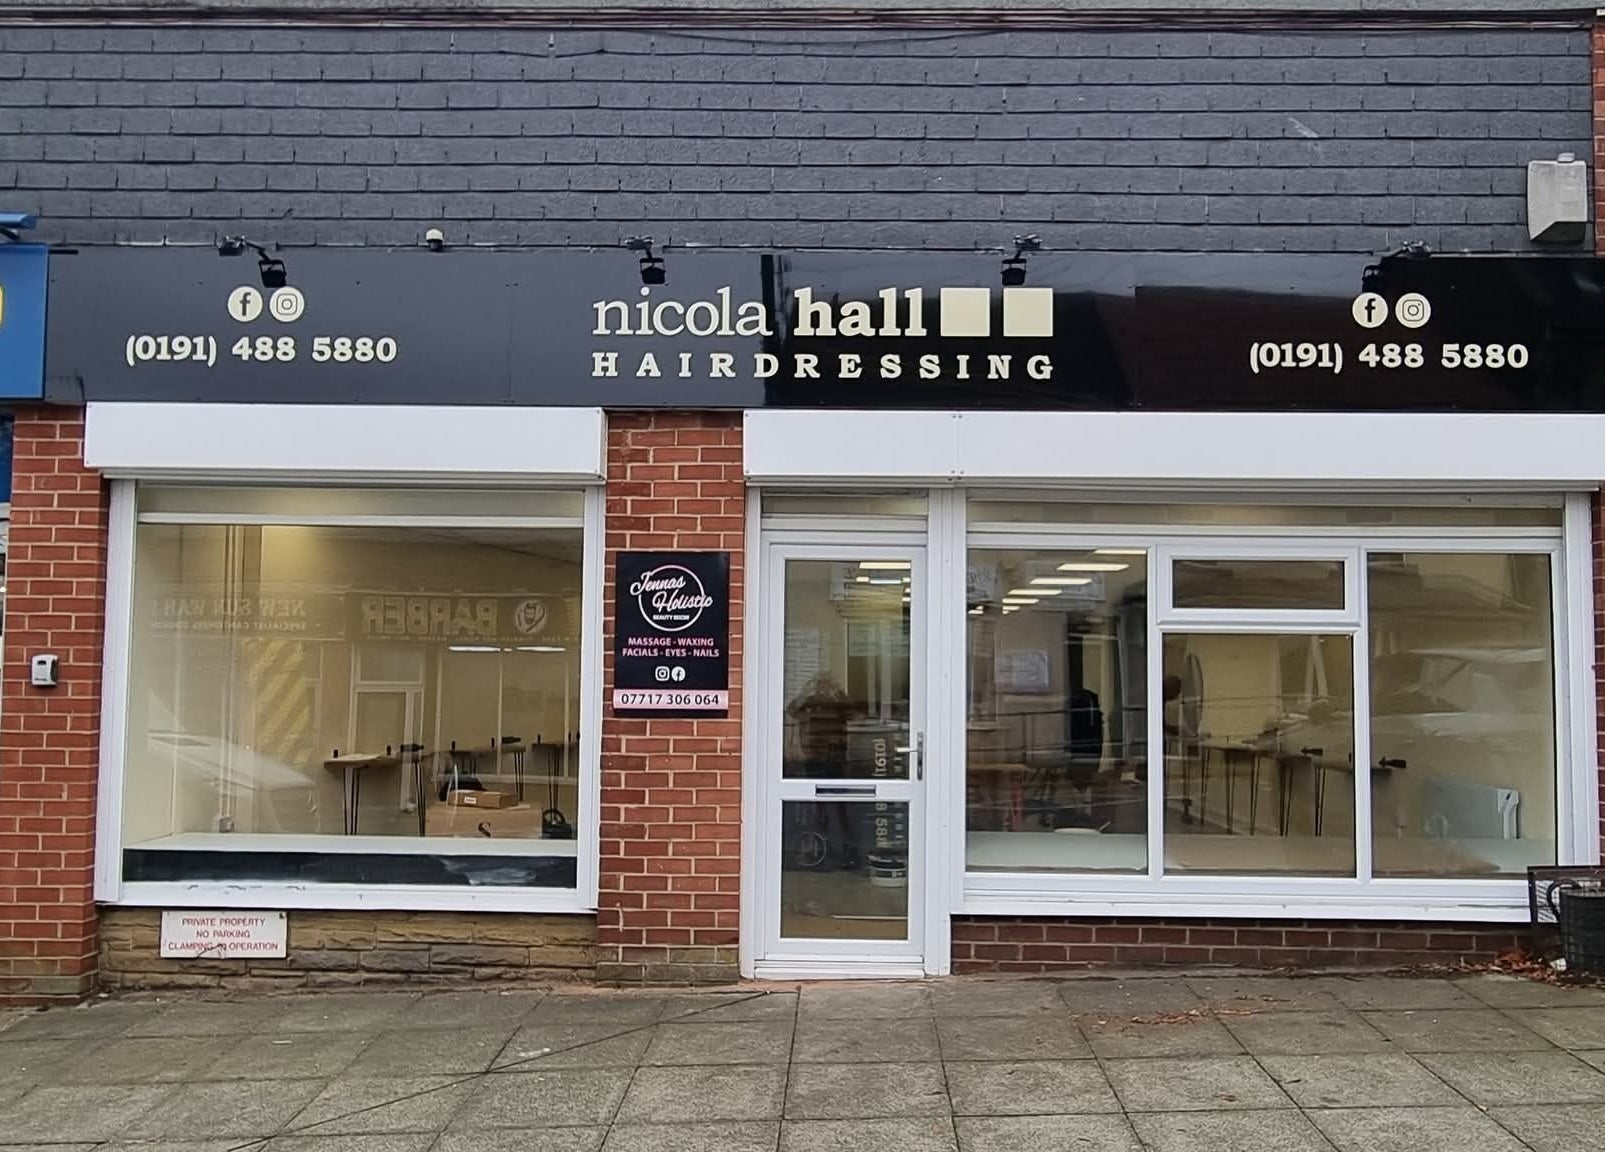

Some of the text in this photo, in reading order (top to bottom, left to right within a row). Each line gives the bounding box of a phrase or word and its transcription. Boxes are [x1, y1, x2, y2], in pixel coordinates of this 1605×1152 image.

[592, 286, 928, 337] nicola hall
[126, 335, 397, 367] (0191) 488 5880
[1250, 342, 1529, 374] (0191) 488 5880
[591, 351, 1054, 380] HAIRDRESSING
[629, 571, 686, 596] Jennas
[651, 588, 714, 613] Holistic
[628, 637, 714, 647] MASSAGE WAXING
[622, 648, 720, 657] FACIALS EYES NAILS
[621, 693, 720, 705] 07717 306 064
[182, 918, 266, 926] PRIVATE PROPERTY
[195, 930, 251, 939] NO PARKING
[168, 941, 214, 951] CLAMPING
[228, 942, 279, 951] OPERATION
